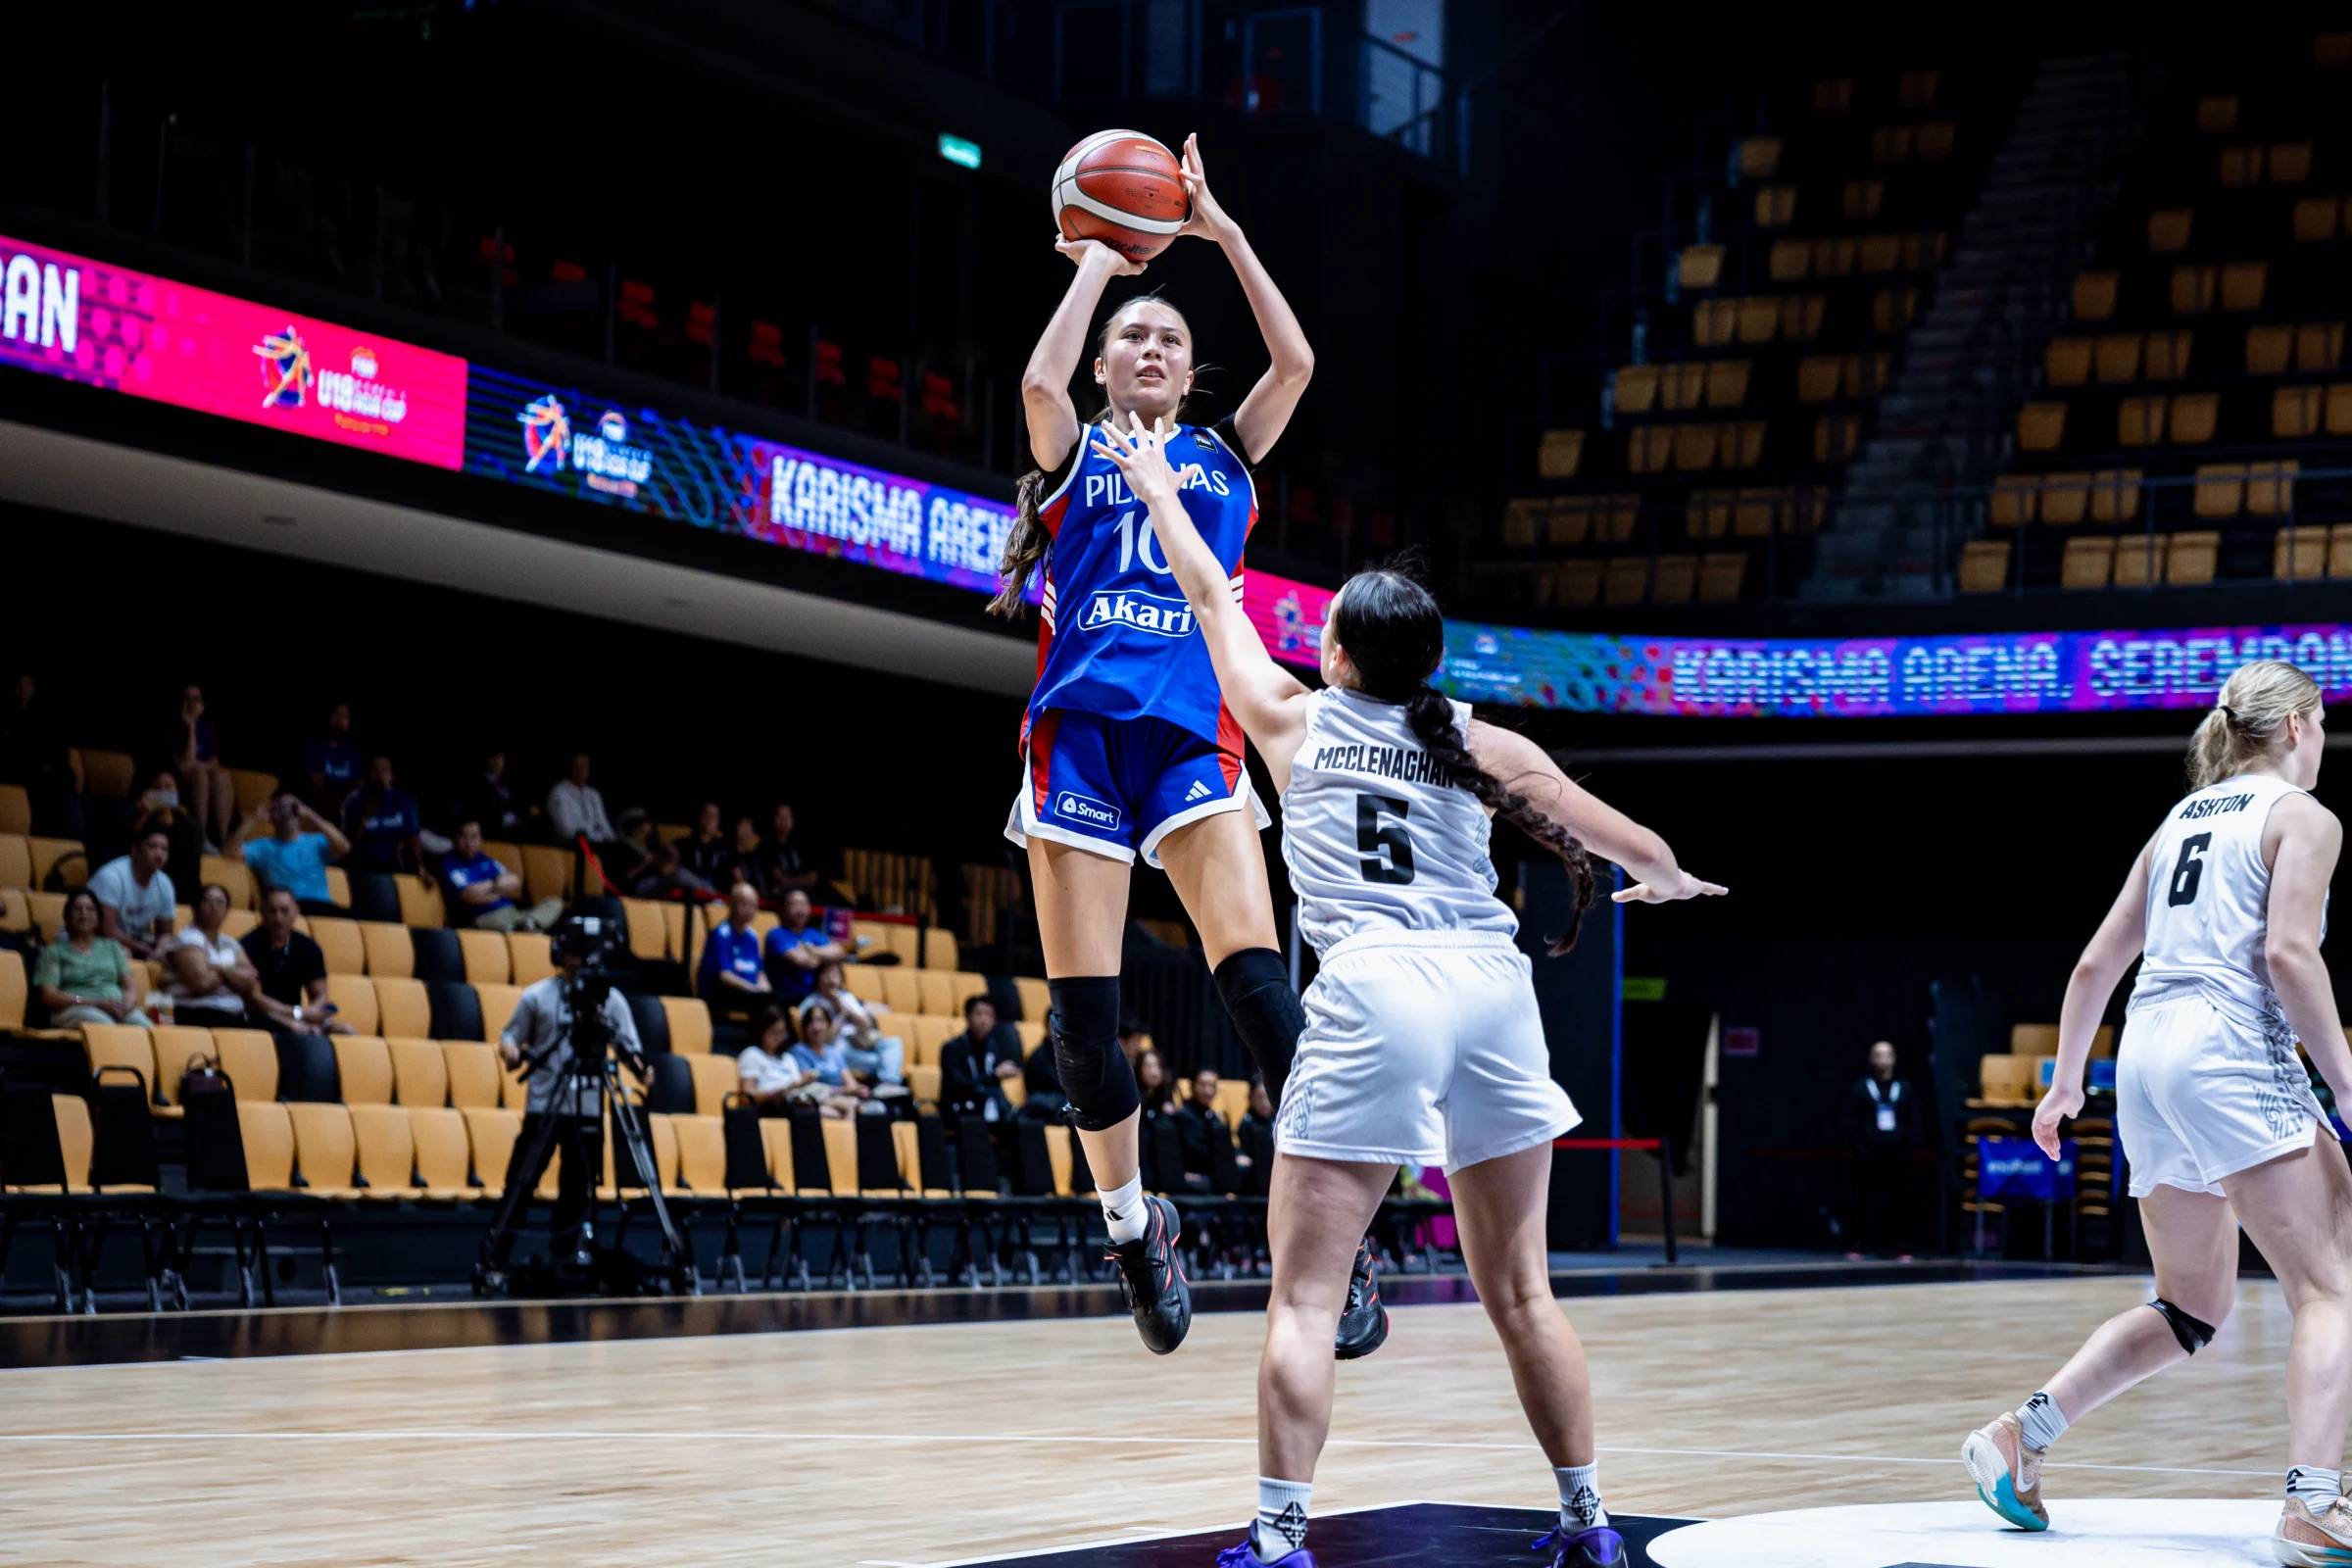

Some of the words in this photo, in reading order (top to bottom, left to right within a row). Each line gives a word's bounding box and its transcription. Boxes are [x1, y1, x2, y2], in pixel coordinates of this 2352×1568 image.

[0, 253, 80, 354] AN
[1085, 463, 1230, 507] PILAS
[770, 455, 922, 559] KARISMA
[929, 497, 1021, 576] AREN
[1085, 594, 1193, 632] Akari
[1673, 647, 1890, 704] KARISMA
[1076, 802, 1114, 824] Smart
[2179, 794, 2256, 819] ASHTON
[1356, 794, 1415, 885] 5
[2168, 831, 2212, 908] 6
